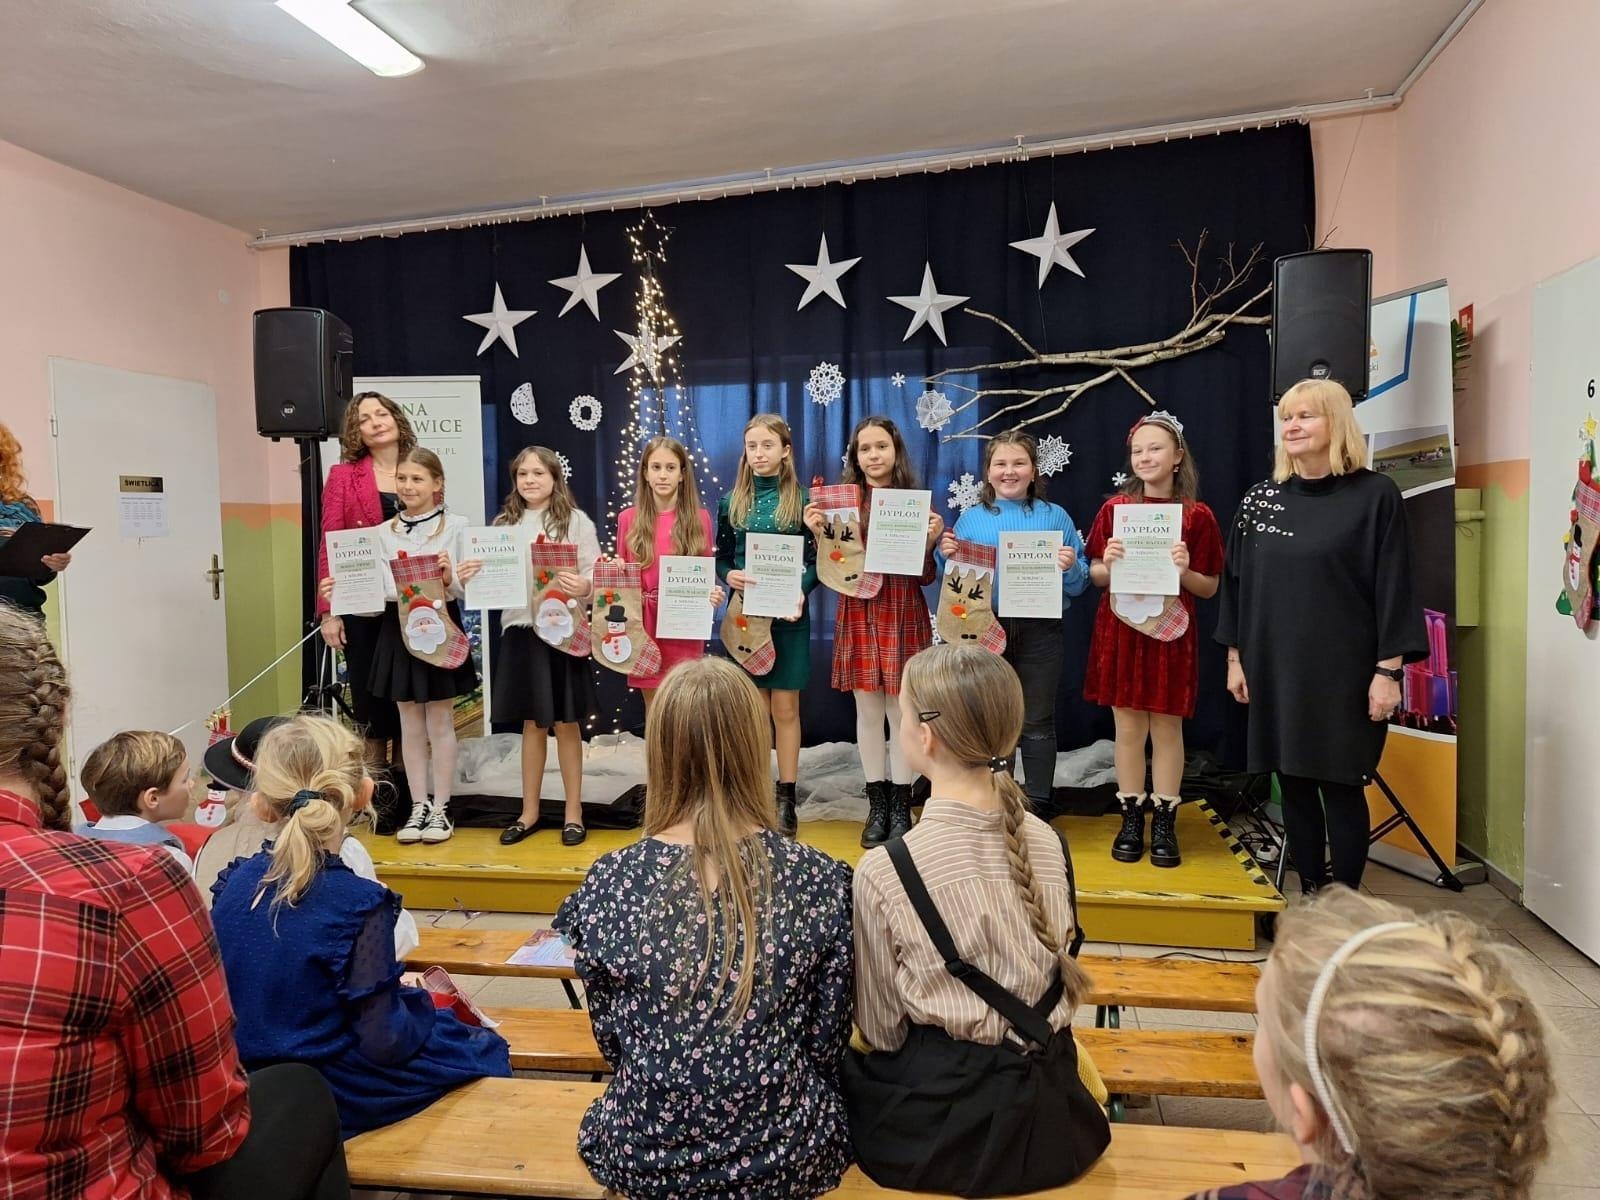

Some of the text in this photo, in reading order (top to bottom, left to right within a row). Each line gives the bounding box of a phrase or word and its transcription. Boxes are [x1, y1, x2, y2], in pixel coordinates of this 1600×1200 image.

[1587, 379, 1595, 398] 6
[402, 403, 428, 416] NA
[413, 419, 463, 433] WICE
[879, 510, 921, 518] DYPLOM
[335, 548, 372, 559] DYPLOM
[473, 545, 515, 553] DYPLOM
[754, 553, 794, 563] DYPLOM
[667, 576, 707, 584] DYPLOM
